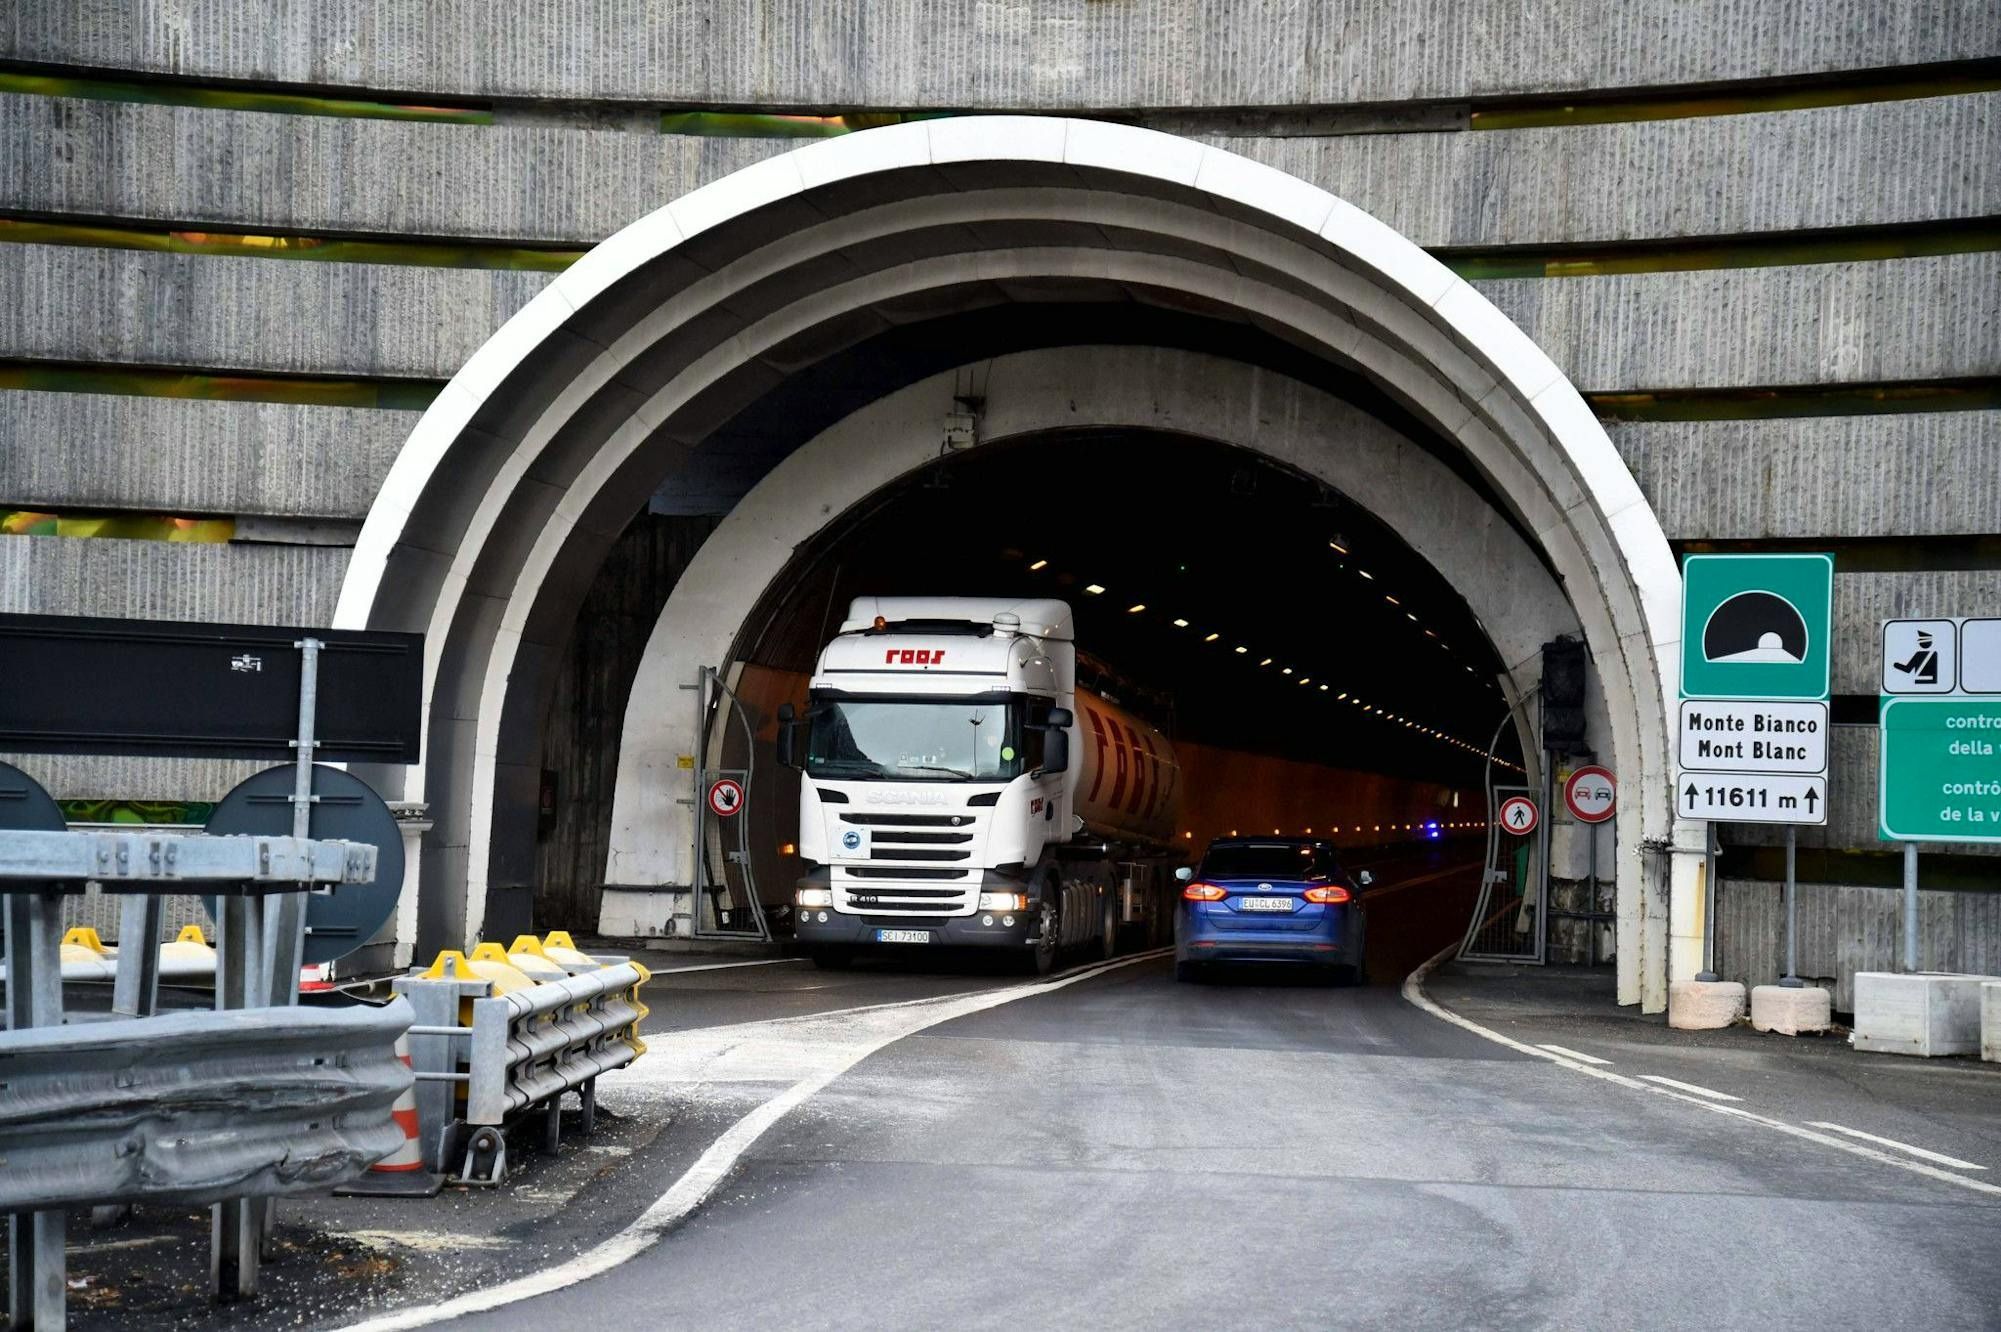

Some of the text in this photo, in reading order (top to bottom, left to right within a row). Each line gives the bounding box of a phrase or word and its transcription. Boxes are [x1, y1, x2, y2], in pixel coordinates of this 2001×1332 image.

[886, 650, 945, 664] roos
[1689, 713, 1817, 733] Monte Bianco
[1698, 740, 1807, 760] Mont Blanc
[1949, 740, 1993, 755] della
[1705, 787, 1797, 808] 11611 m
[1940, 806, 1961, 821] de
[1967, 807, 1984, 822] la
